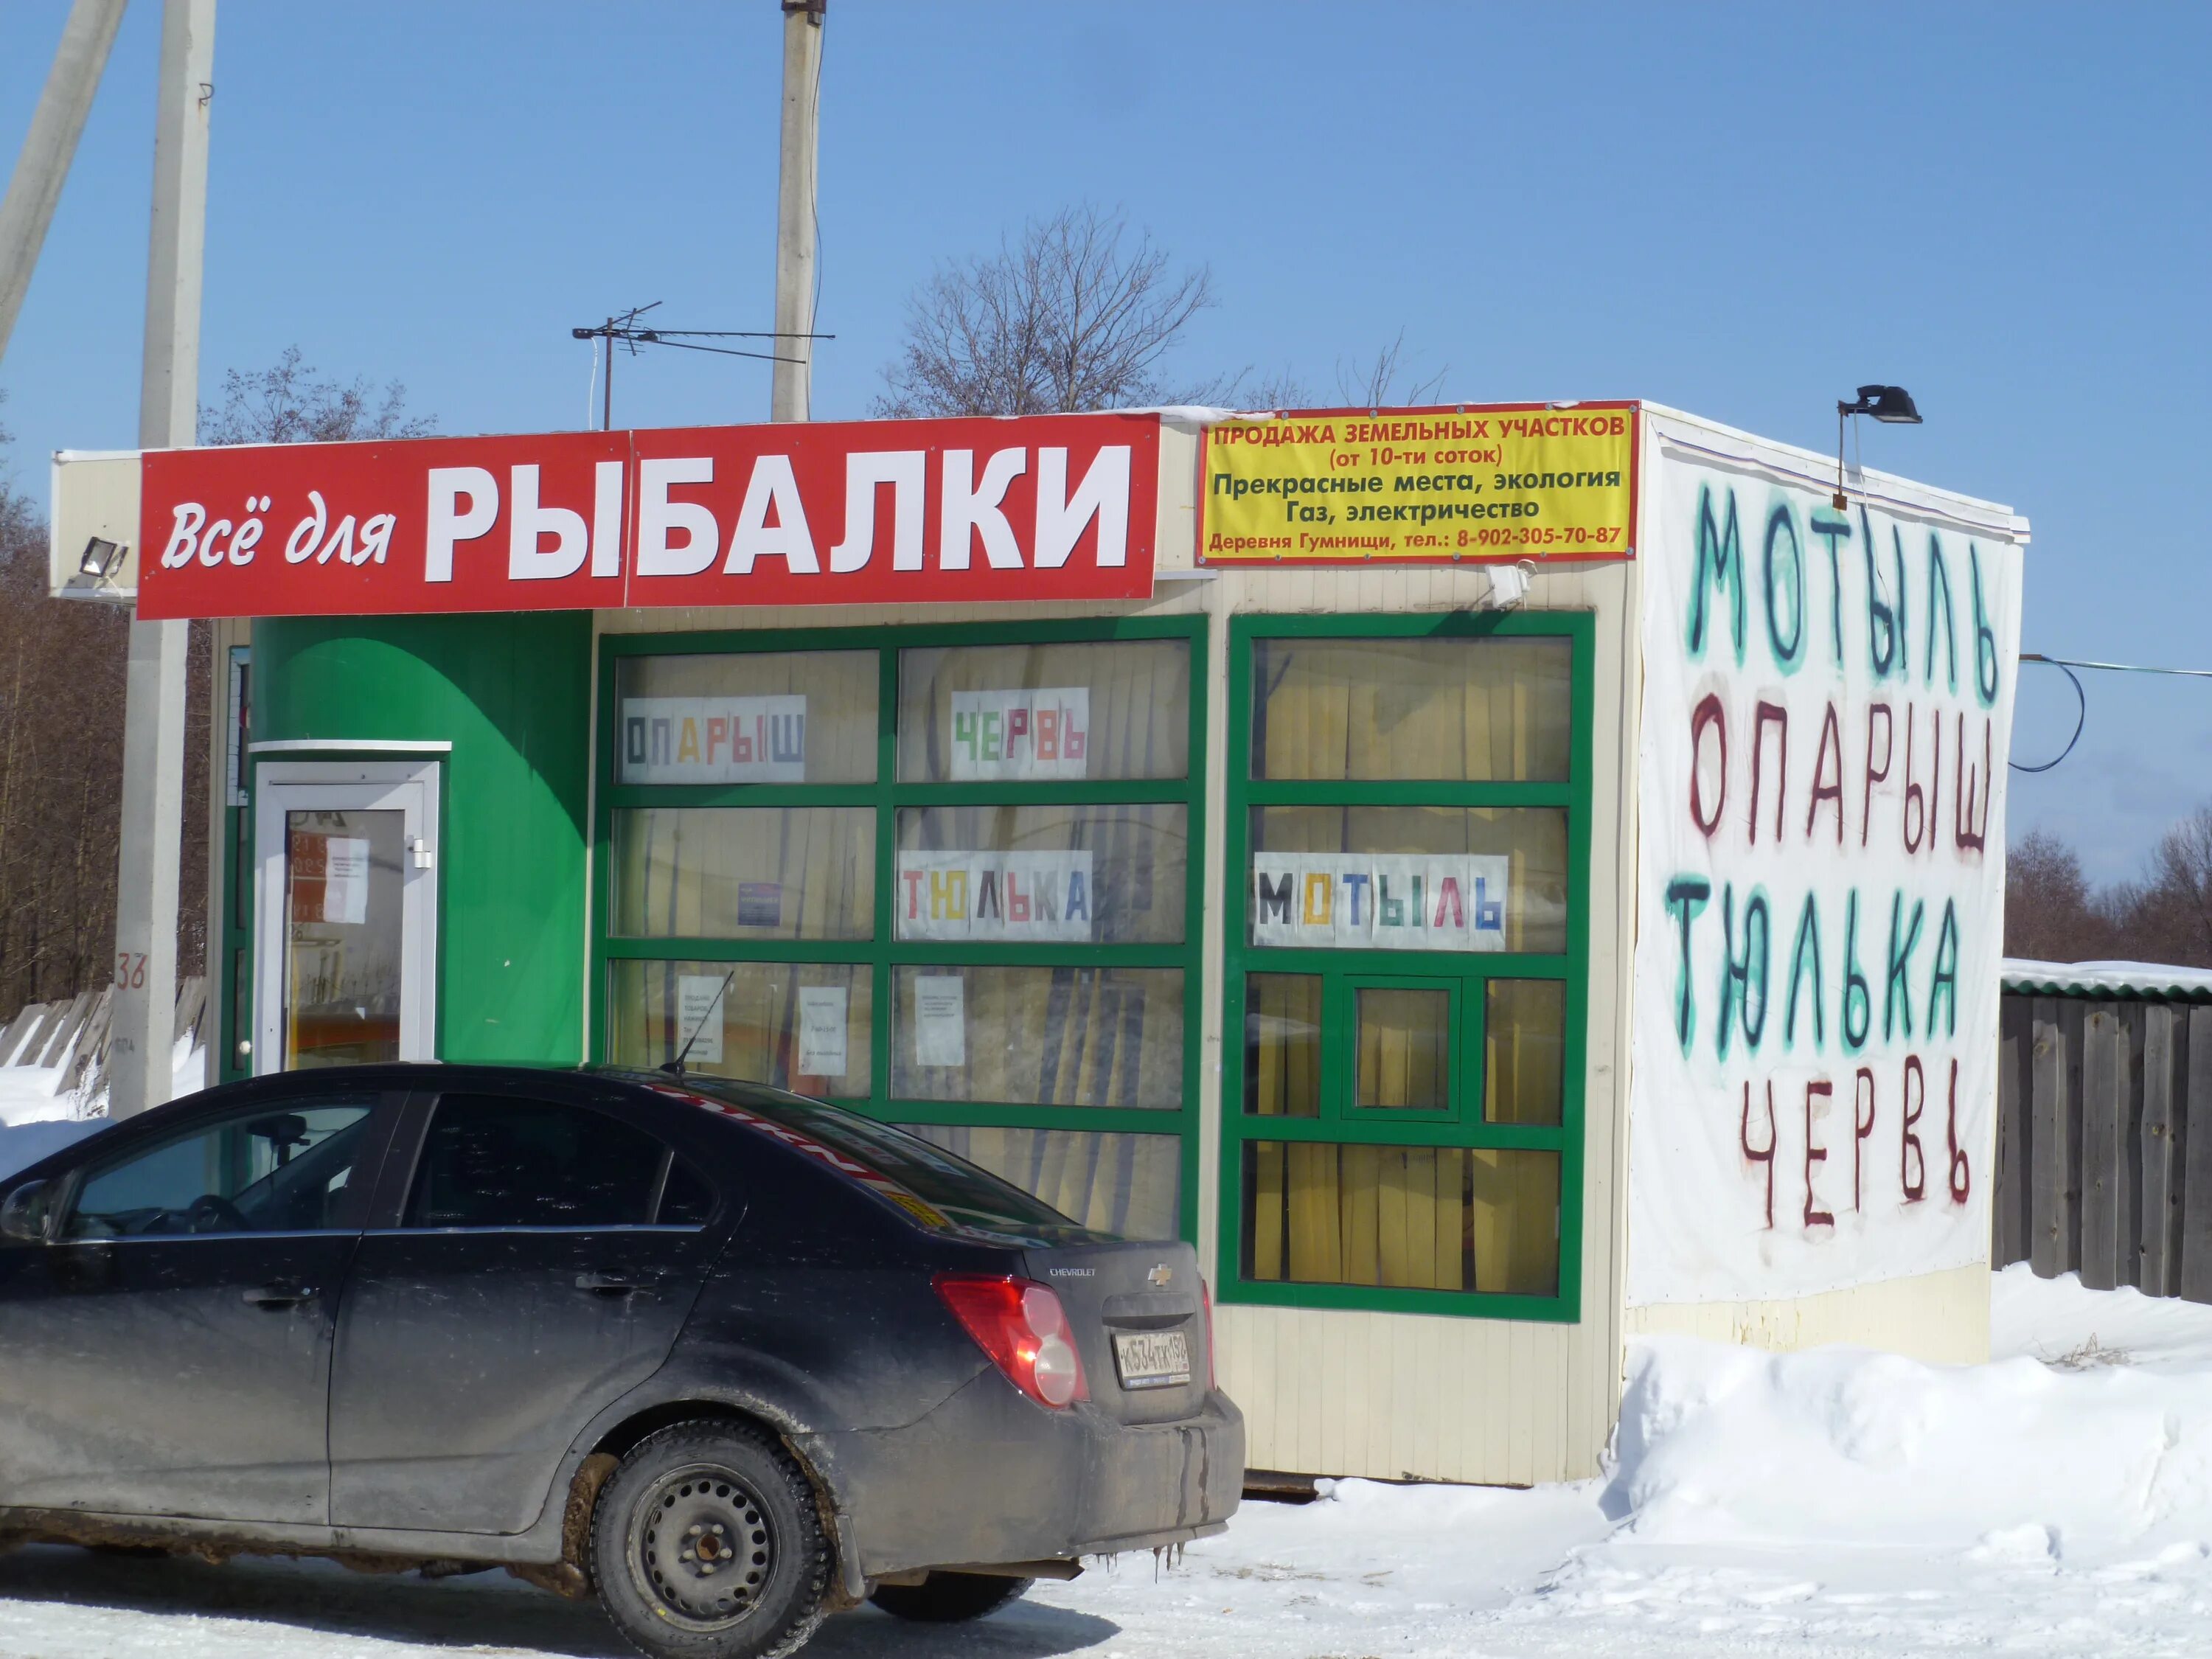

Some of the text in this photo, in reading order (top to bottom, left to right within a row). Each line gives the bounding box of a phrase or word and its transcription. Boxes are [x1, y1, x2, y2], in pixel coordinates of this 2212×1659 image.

[1214, 417, 1625, 447] ПРОДАЖА ЗЕМЕЛЬНЫХ УЧАСТКОВ
[1330, 444, 1503, 470] (от 10-ти соток)
[1214, 470, 1621, 501] Прекрасные места, экология
[161, 445, 1131, 582] Всё для РЫБАЛКИ
[1287, 501, 1540, 526] Газ, электричество
[1209, 526, 1621, 553] Деревня Гумнищи, тел.: 8-902-305-70-87
[1688, 481, 1999, 708] МОТЫЛЬ
[627, 714, 804, 765] ОПАРЫШ
[956, 709, 1085, 760] ЧЕРВЬ
[1689, 692, 1992, 854] ОПАРЫШ
[903, 871, 1088, 921] ТЮЛЬКА
[1259, 873, 1501, 930] МОТЫЛЬ
[117, 953, 147, 990] 36
[1666, 876, 1959, 1056] ТЮЛЬКА
[1740, 1055, 1970, 1229] ЧЕРВЬ
[1049, 1268, 1095, 1276] CHEVROLET
